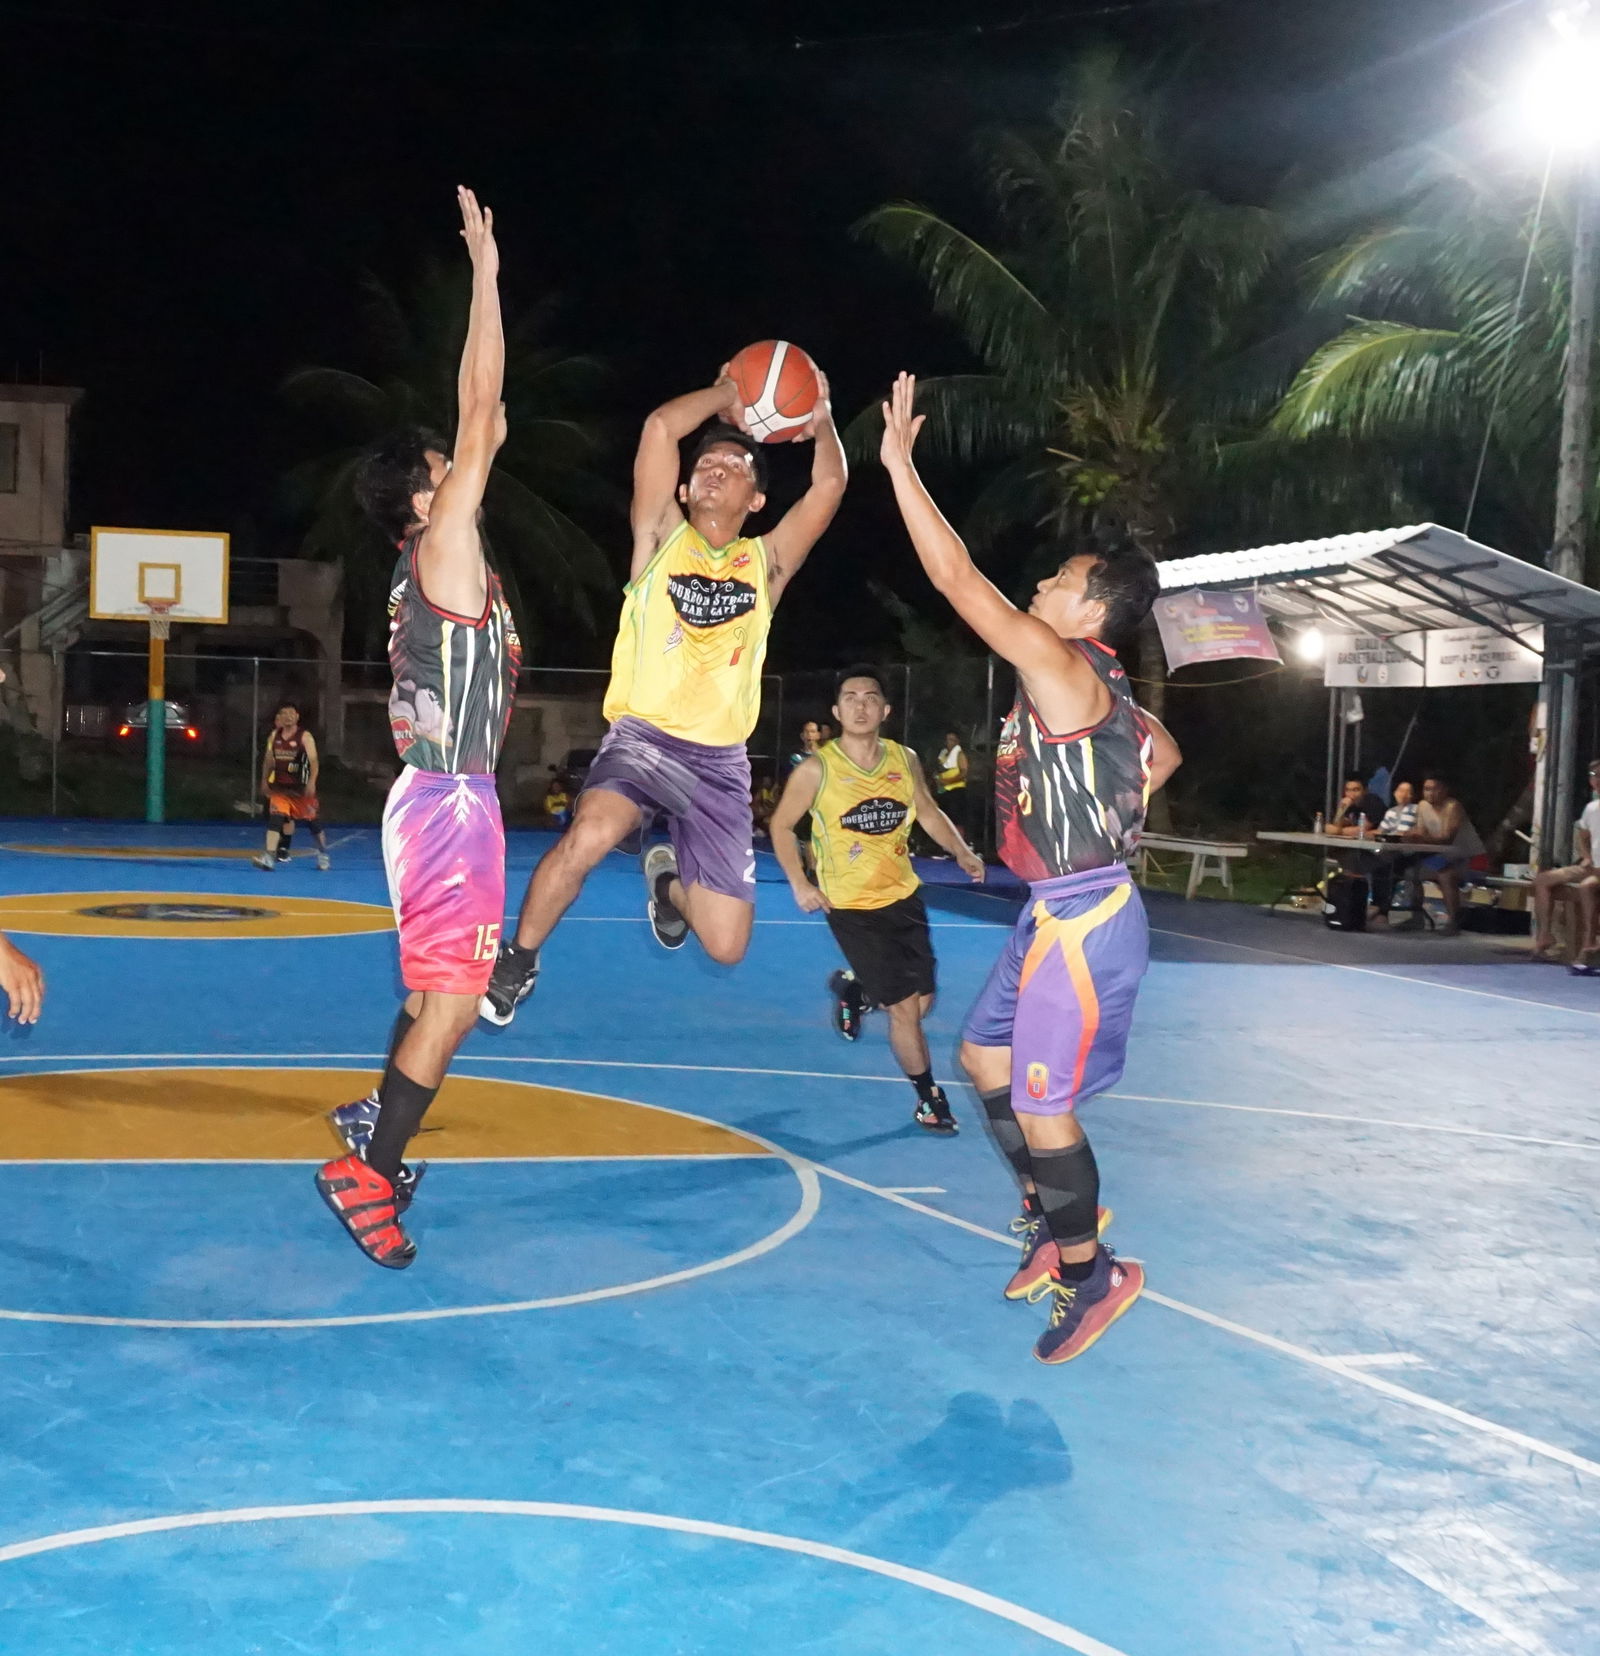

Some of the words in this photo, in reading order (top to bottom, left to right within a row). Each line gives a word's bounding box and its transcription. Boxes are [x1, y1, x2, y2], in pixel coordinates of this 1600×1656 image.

[713, 592, 756, 606] STREET
[681, 602, 703, 617] BAR
[841, 811, 878, 825] BOURBON
[860, 821, 875, 830] BAR
[473, 923, 500, 960] 15
[1027, 1062, 1049, 1101] 8
